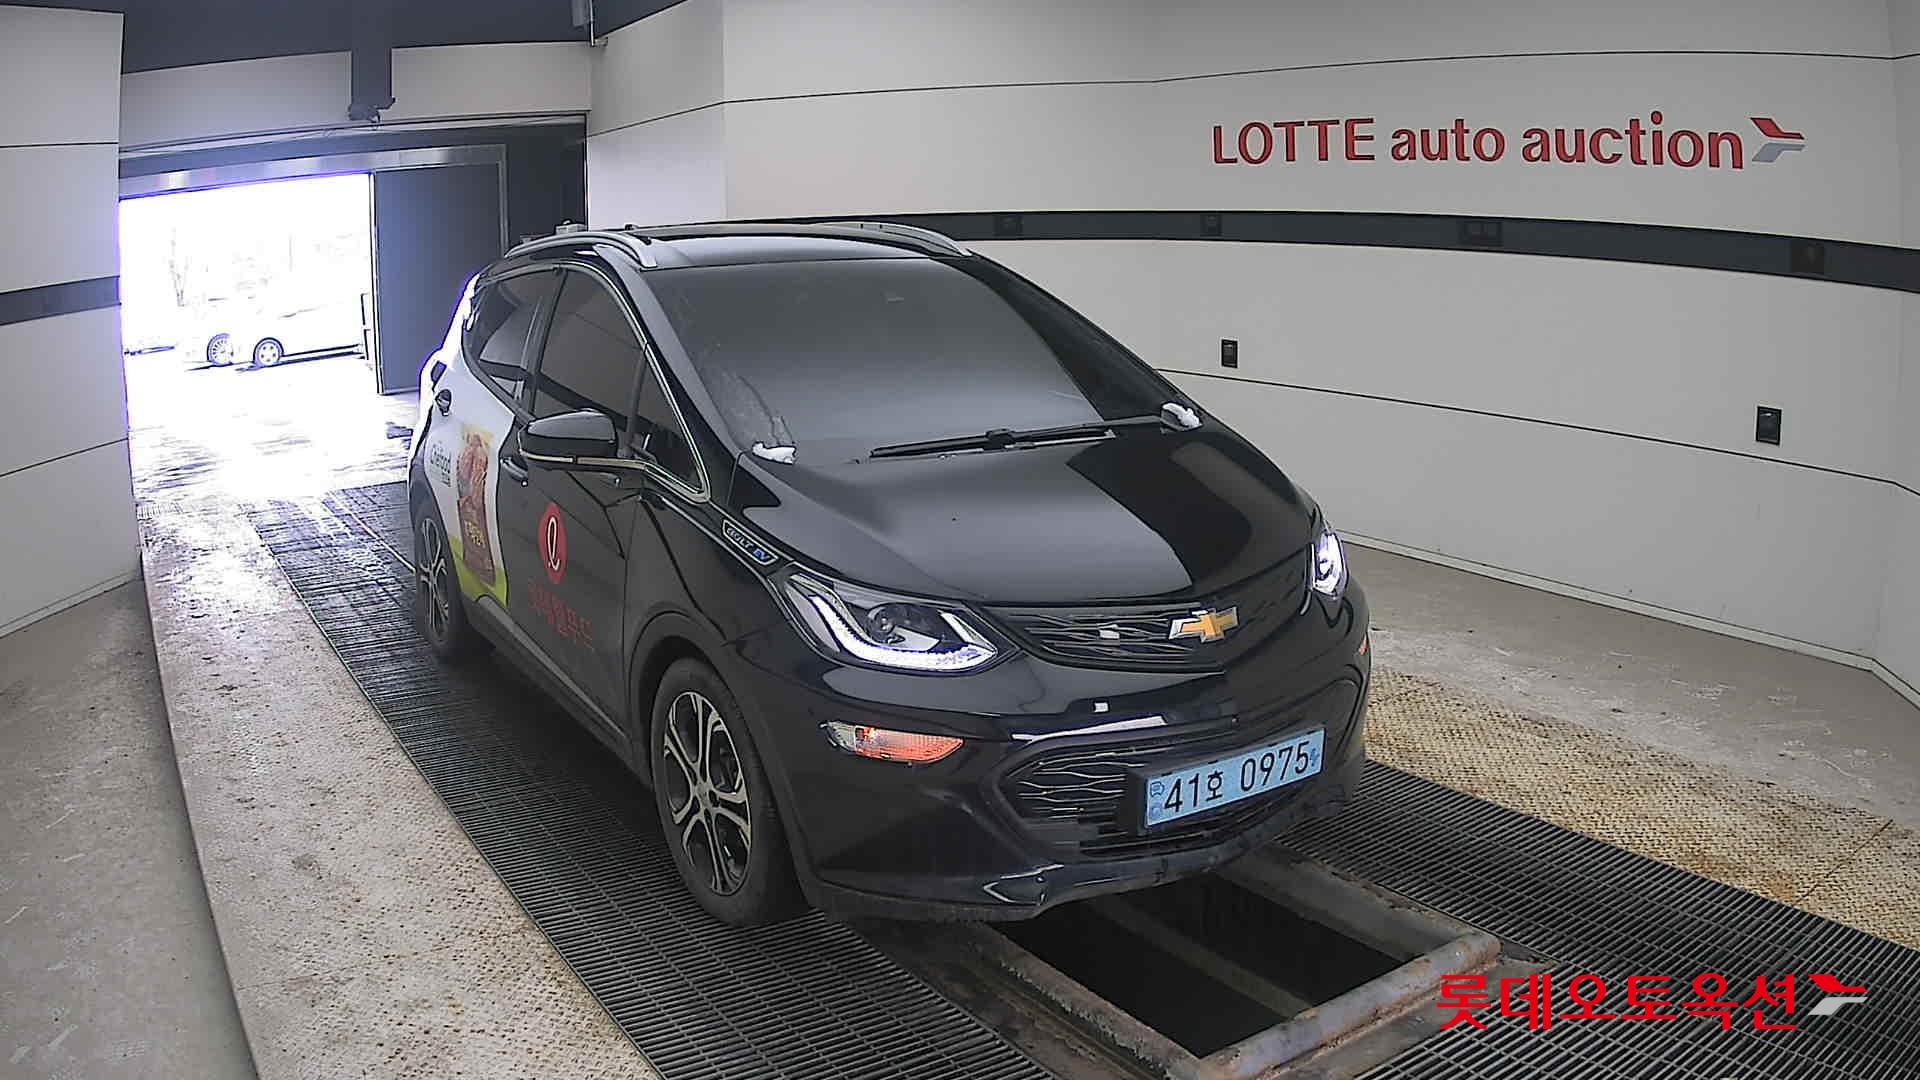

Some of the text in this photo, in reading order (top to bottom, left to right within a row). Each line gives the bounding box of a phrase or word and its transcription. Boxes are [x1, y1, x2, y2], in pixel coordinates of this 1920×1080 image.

[1212, 110, 1744, 170] LOTTE auto auction
[1164, 740, 1310, 813] 41호 0975
